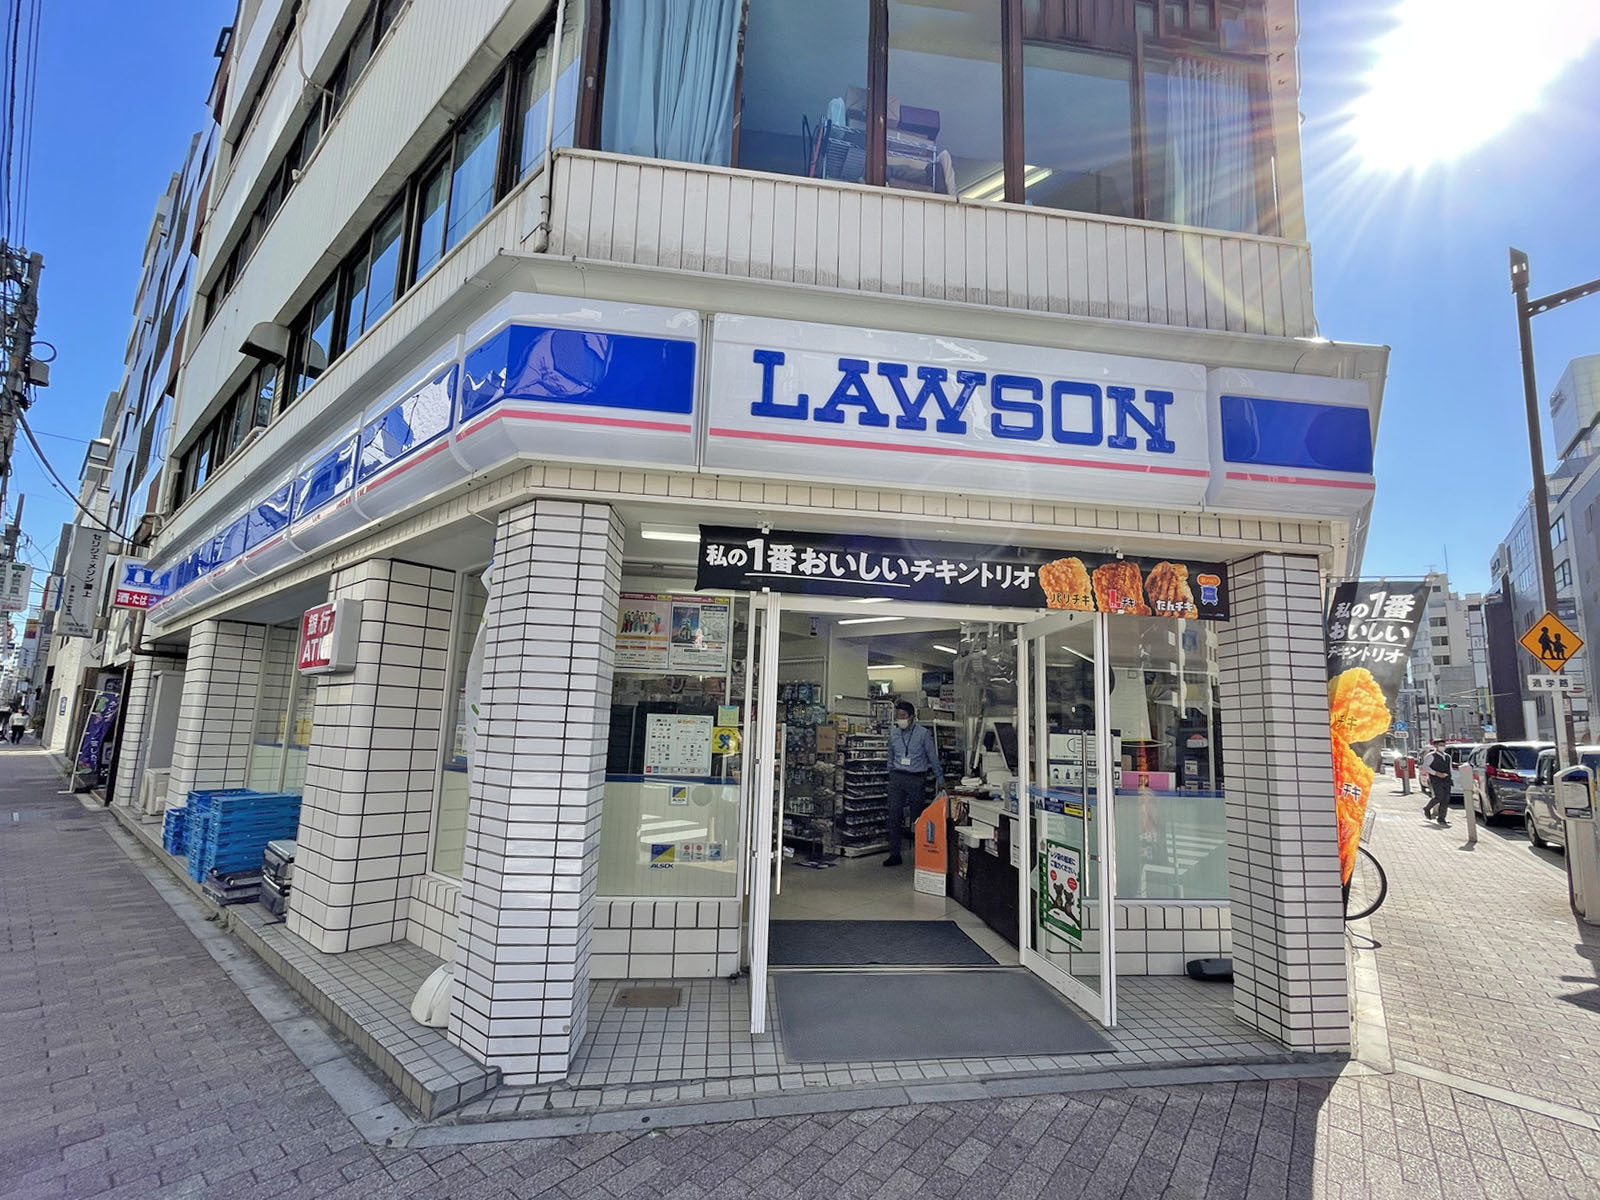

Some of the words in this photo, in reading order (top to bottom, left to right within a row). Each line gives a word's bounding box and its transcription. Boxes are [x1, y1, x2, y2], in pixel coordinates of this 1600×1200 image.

[751, 349, 1176, 454] LAWSON
[706, 538, 1036, 590] 私の1番おいしいチキントリオ
[117, 591, 149, 606] 酒・たば
[1051, 593, 1090, 605] パリチキ
[1156, 600, 1193, 613] たんチキ
[1335, 591, 1416, 618] 私の1番
[307, 610, 331, 636] 銀行
[1329, 622, 1410, 642] おいしい
[1327, 646, 1404, 664] チキントリオ
[1532, 678, 1569, 688] 通学路
